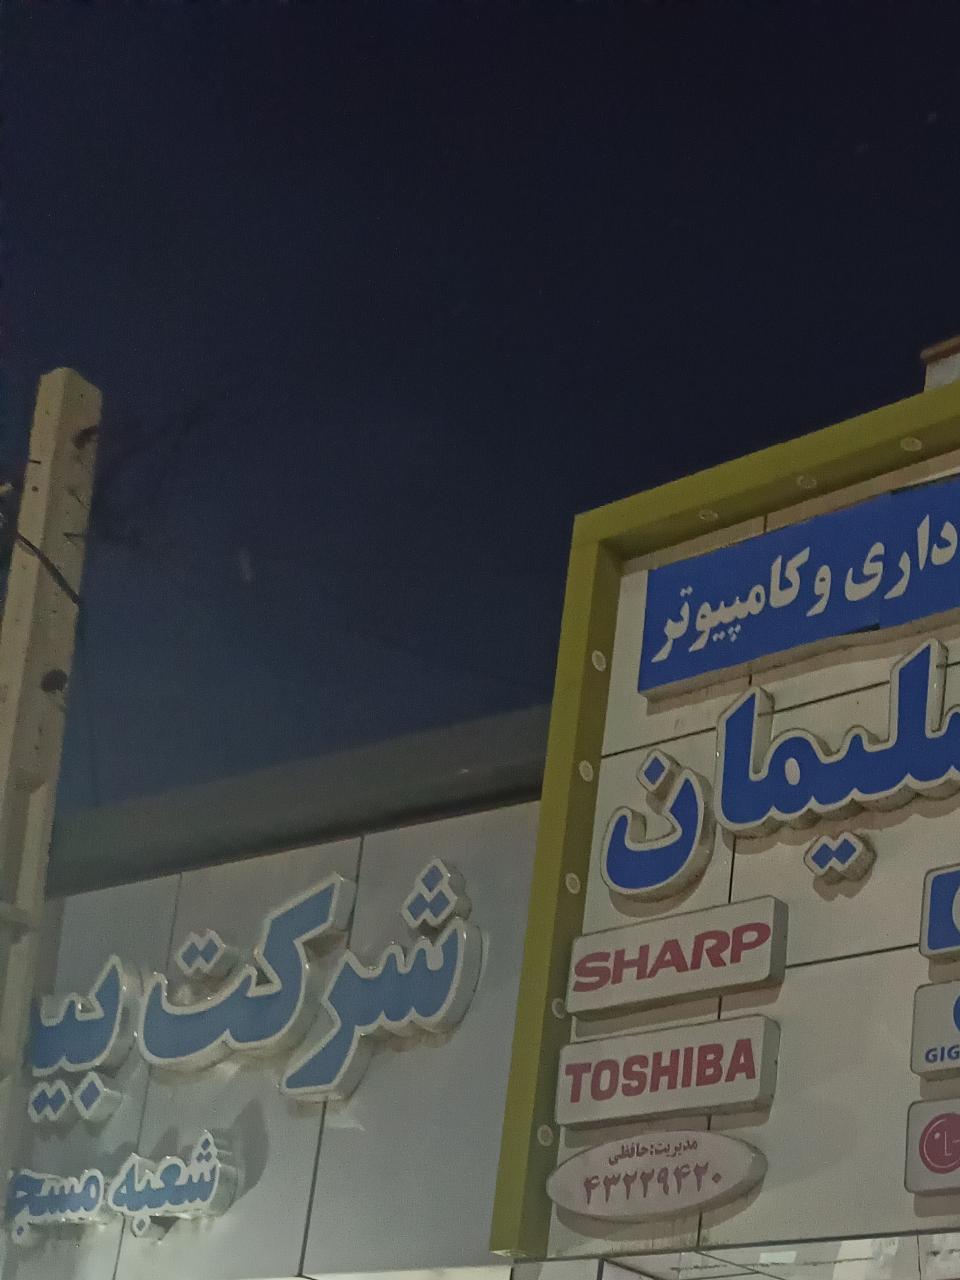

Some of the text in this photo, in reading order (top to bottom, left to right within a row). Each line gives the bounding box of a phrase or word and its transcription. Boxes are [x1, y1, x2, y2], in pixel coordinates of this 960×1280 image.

[135, 857, 468, 1095] شرکت
[573, 921, 771, 993] SHARP
[565, 1038, 757, 1104] TOSHIBA
[107, 1129, 222, 1238] شعبه
